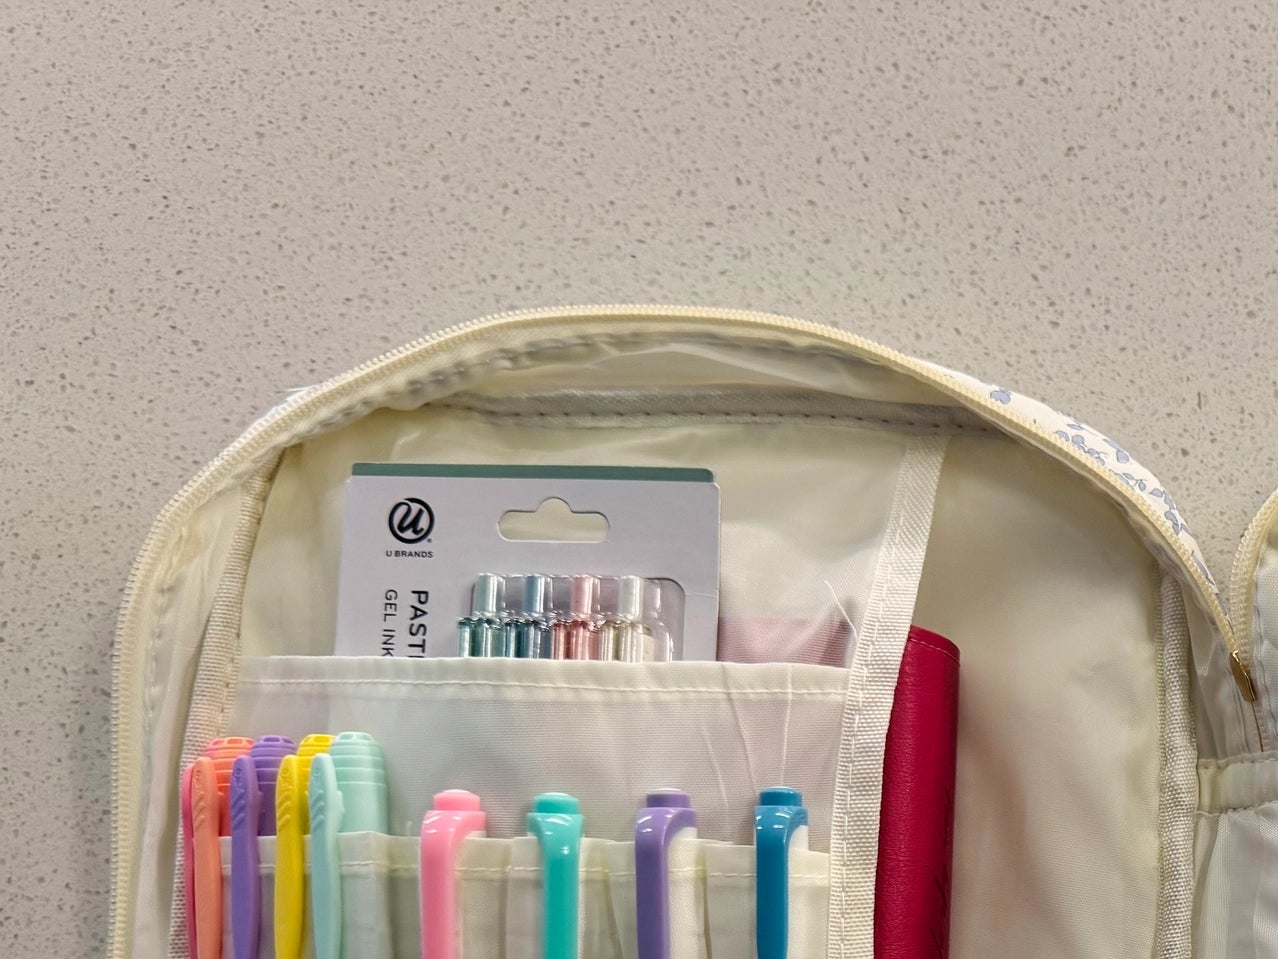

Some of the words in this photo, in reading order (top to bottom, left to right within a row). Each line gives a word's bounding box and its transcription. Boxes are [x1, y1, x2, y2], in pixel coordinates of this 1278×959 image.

[385, 550, 393, 558] U
[394, 550, 434, 559] BRANDS
[383, 589, 398, 622] GEL
[407, 590, 429, 659] PAST
[381, 629, 396, 657] INK
